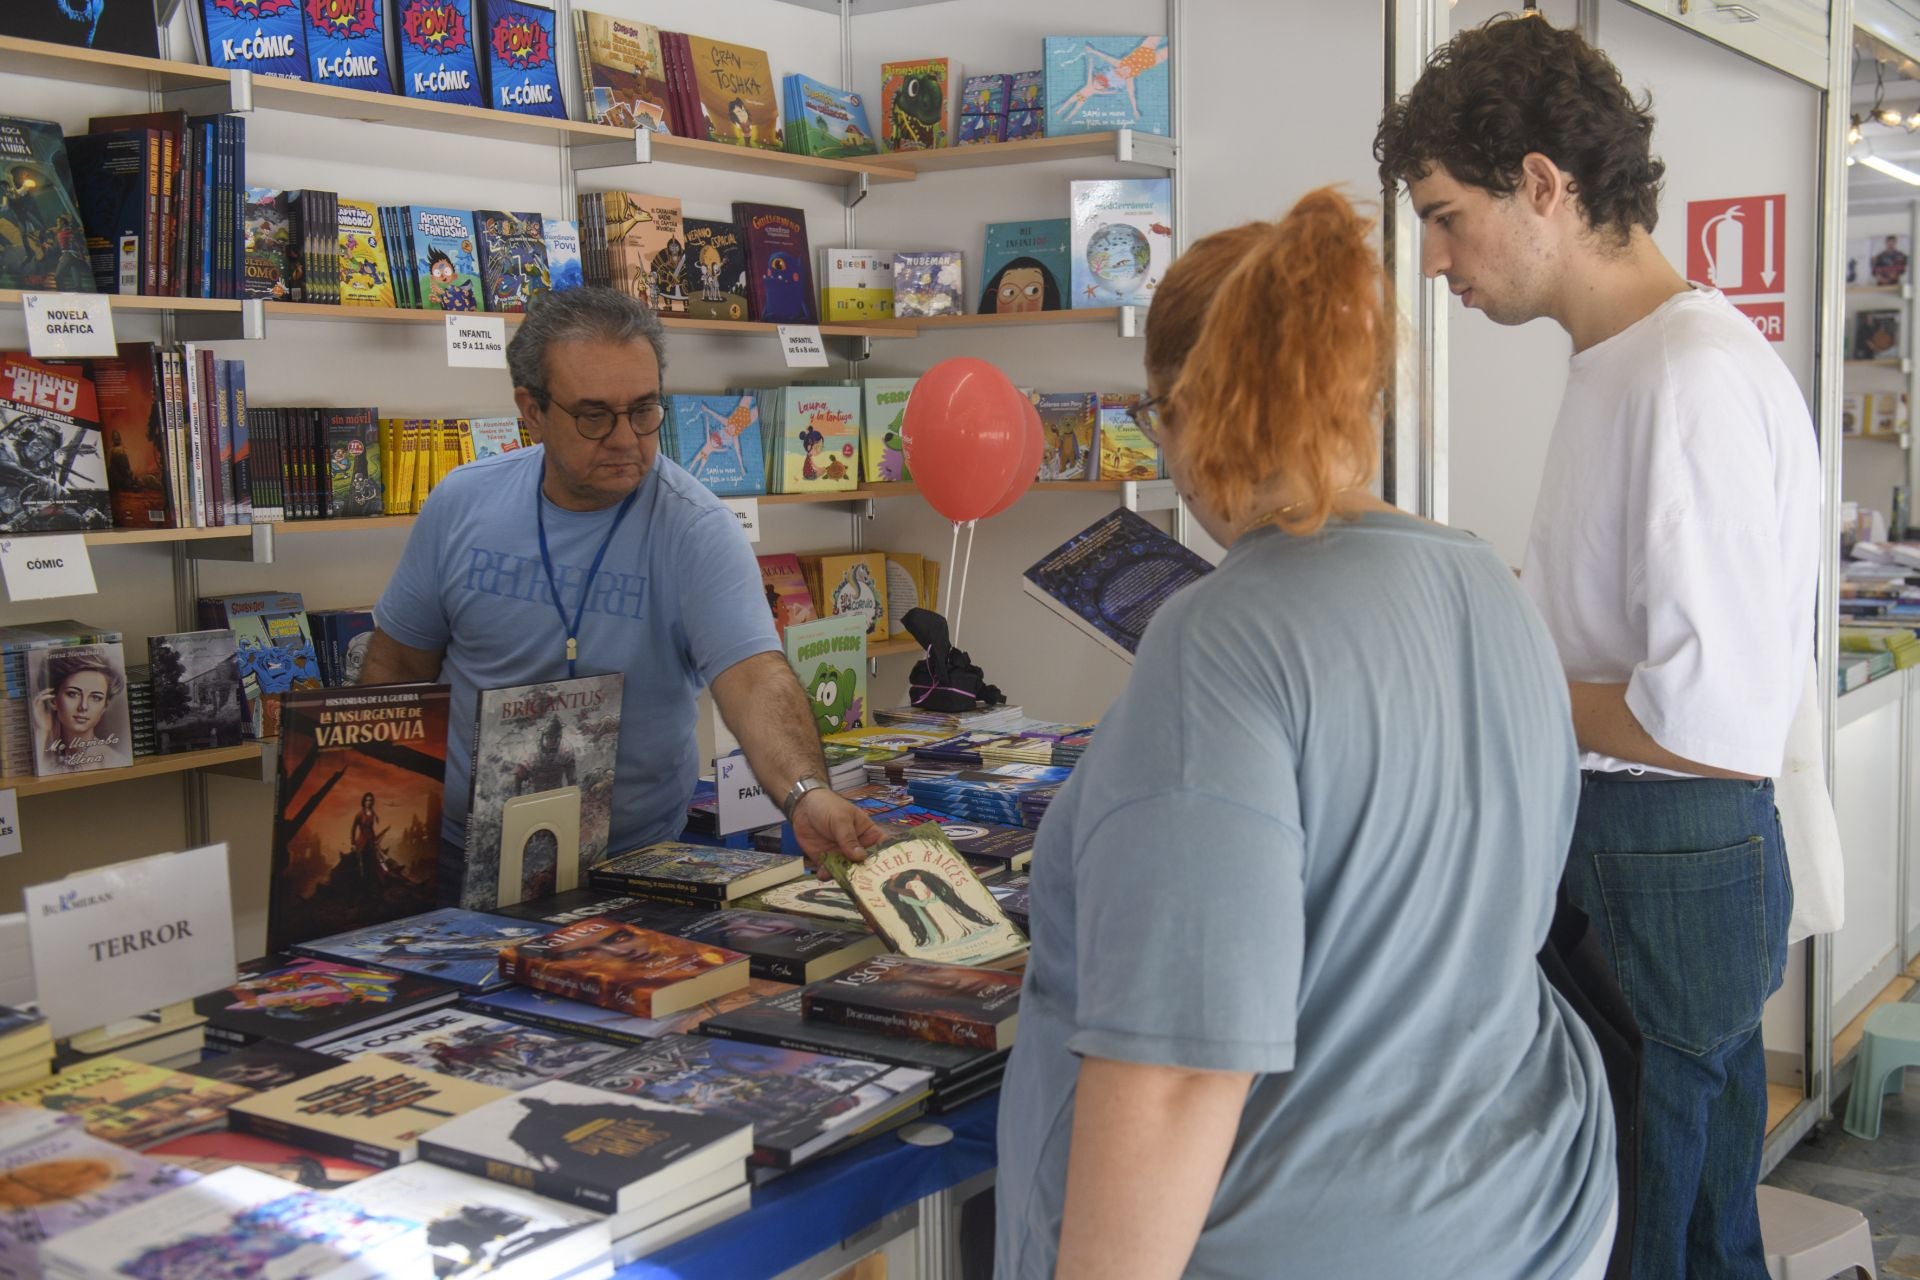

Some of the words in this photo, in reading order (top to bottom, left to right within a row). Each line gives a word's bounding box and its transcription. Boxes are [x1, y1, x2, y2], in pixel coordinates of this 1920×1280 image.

[412, 10, 456, 37] POW!
[222, 27, 294, 61] K-CÓMIC
[500, 26, 541, 51] POW!
[317, 47, 378, 79] K-CÓMIC
[711, 46, 741, 70] GRAN
[414, 64, 470, 94] K-CÓMIC
[711, 68, 761, 96] TOSHKA
[501, 78, 553, 106] K-CÓMIC
[337, 215, 373, 228] ONDONGO
[420, 212, 461, 228] APRENDIZ
[424, 224, 469, 238] FANTASMA
[554, 240, 576, 254] Povy
[906, 256, 951, 266] NUBEMAN
[47, 310, 89, 321] NOVELA
[46, 322, 94, 334] GRÁFICA
[459, 329, 492, 339] INFANTIL
[462, 341, 468, 350] 9
[469, 342, 473, 350] A
[474, 342, 484, 350] 11
[486, 342, 501, 351] AÑOS
[789, 336, 813, 344] INFANTIL
[4, 366, 79, 393] JOHNNY
[12, 380, 78, 413] RED
[798, 400, 828, 415] Laura
[16, 402, 75, 425] HURRICANE
[816, 410, 825, 421] la
[825, 408, 854, 424] tortuga
[26, 557, 64, 570] CÓMIC
[797, 638, 831, 662] PERRO
[830, 635, 862, 652] VERDE
[325, 696, 367, 706] HISTORIAS
[367, 695, 376, 704] DE
[378, 694, 388, 703] LA
[388, 693, 419, 703] GUERRA
[502, 689, 604, 719] BRIGANTUS
[320, 711, 332, 724] LA
[334, 708, 407, 723] INSURGENTE
[408, 707, 423, 717] DE
[315, 719, 425, 747] VARSOVIA
[868, 850, 914, 877] TIENE
[88, 919, 193, 962] TERROR
[362, 1014, 464, 1050] CONDE
